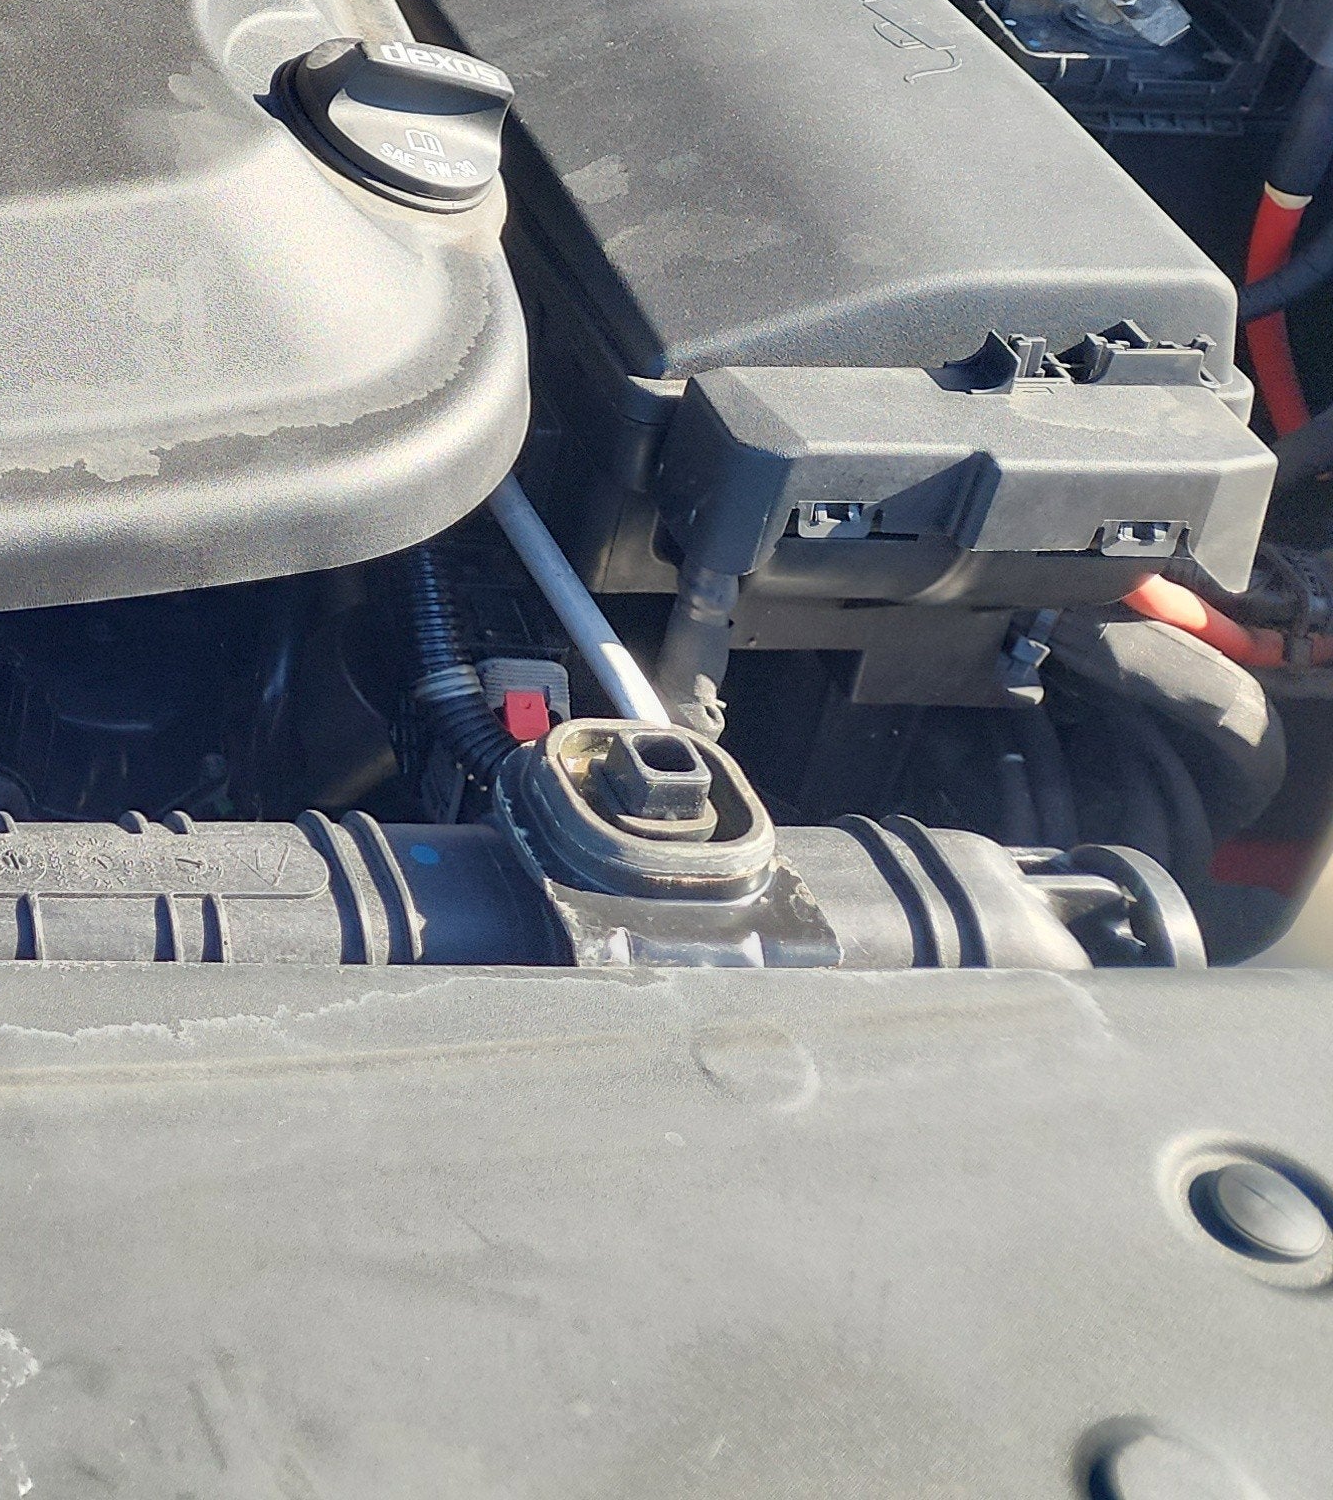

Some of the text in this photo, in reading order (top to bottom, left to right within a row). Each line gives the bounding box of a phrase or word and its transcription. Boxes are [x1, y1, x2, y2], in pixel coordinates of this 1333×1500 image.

[379, 41, 502, 87] dexos
[379, 142, 478, 179] SAE 5W-30
